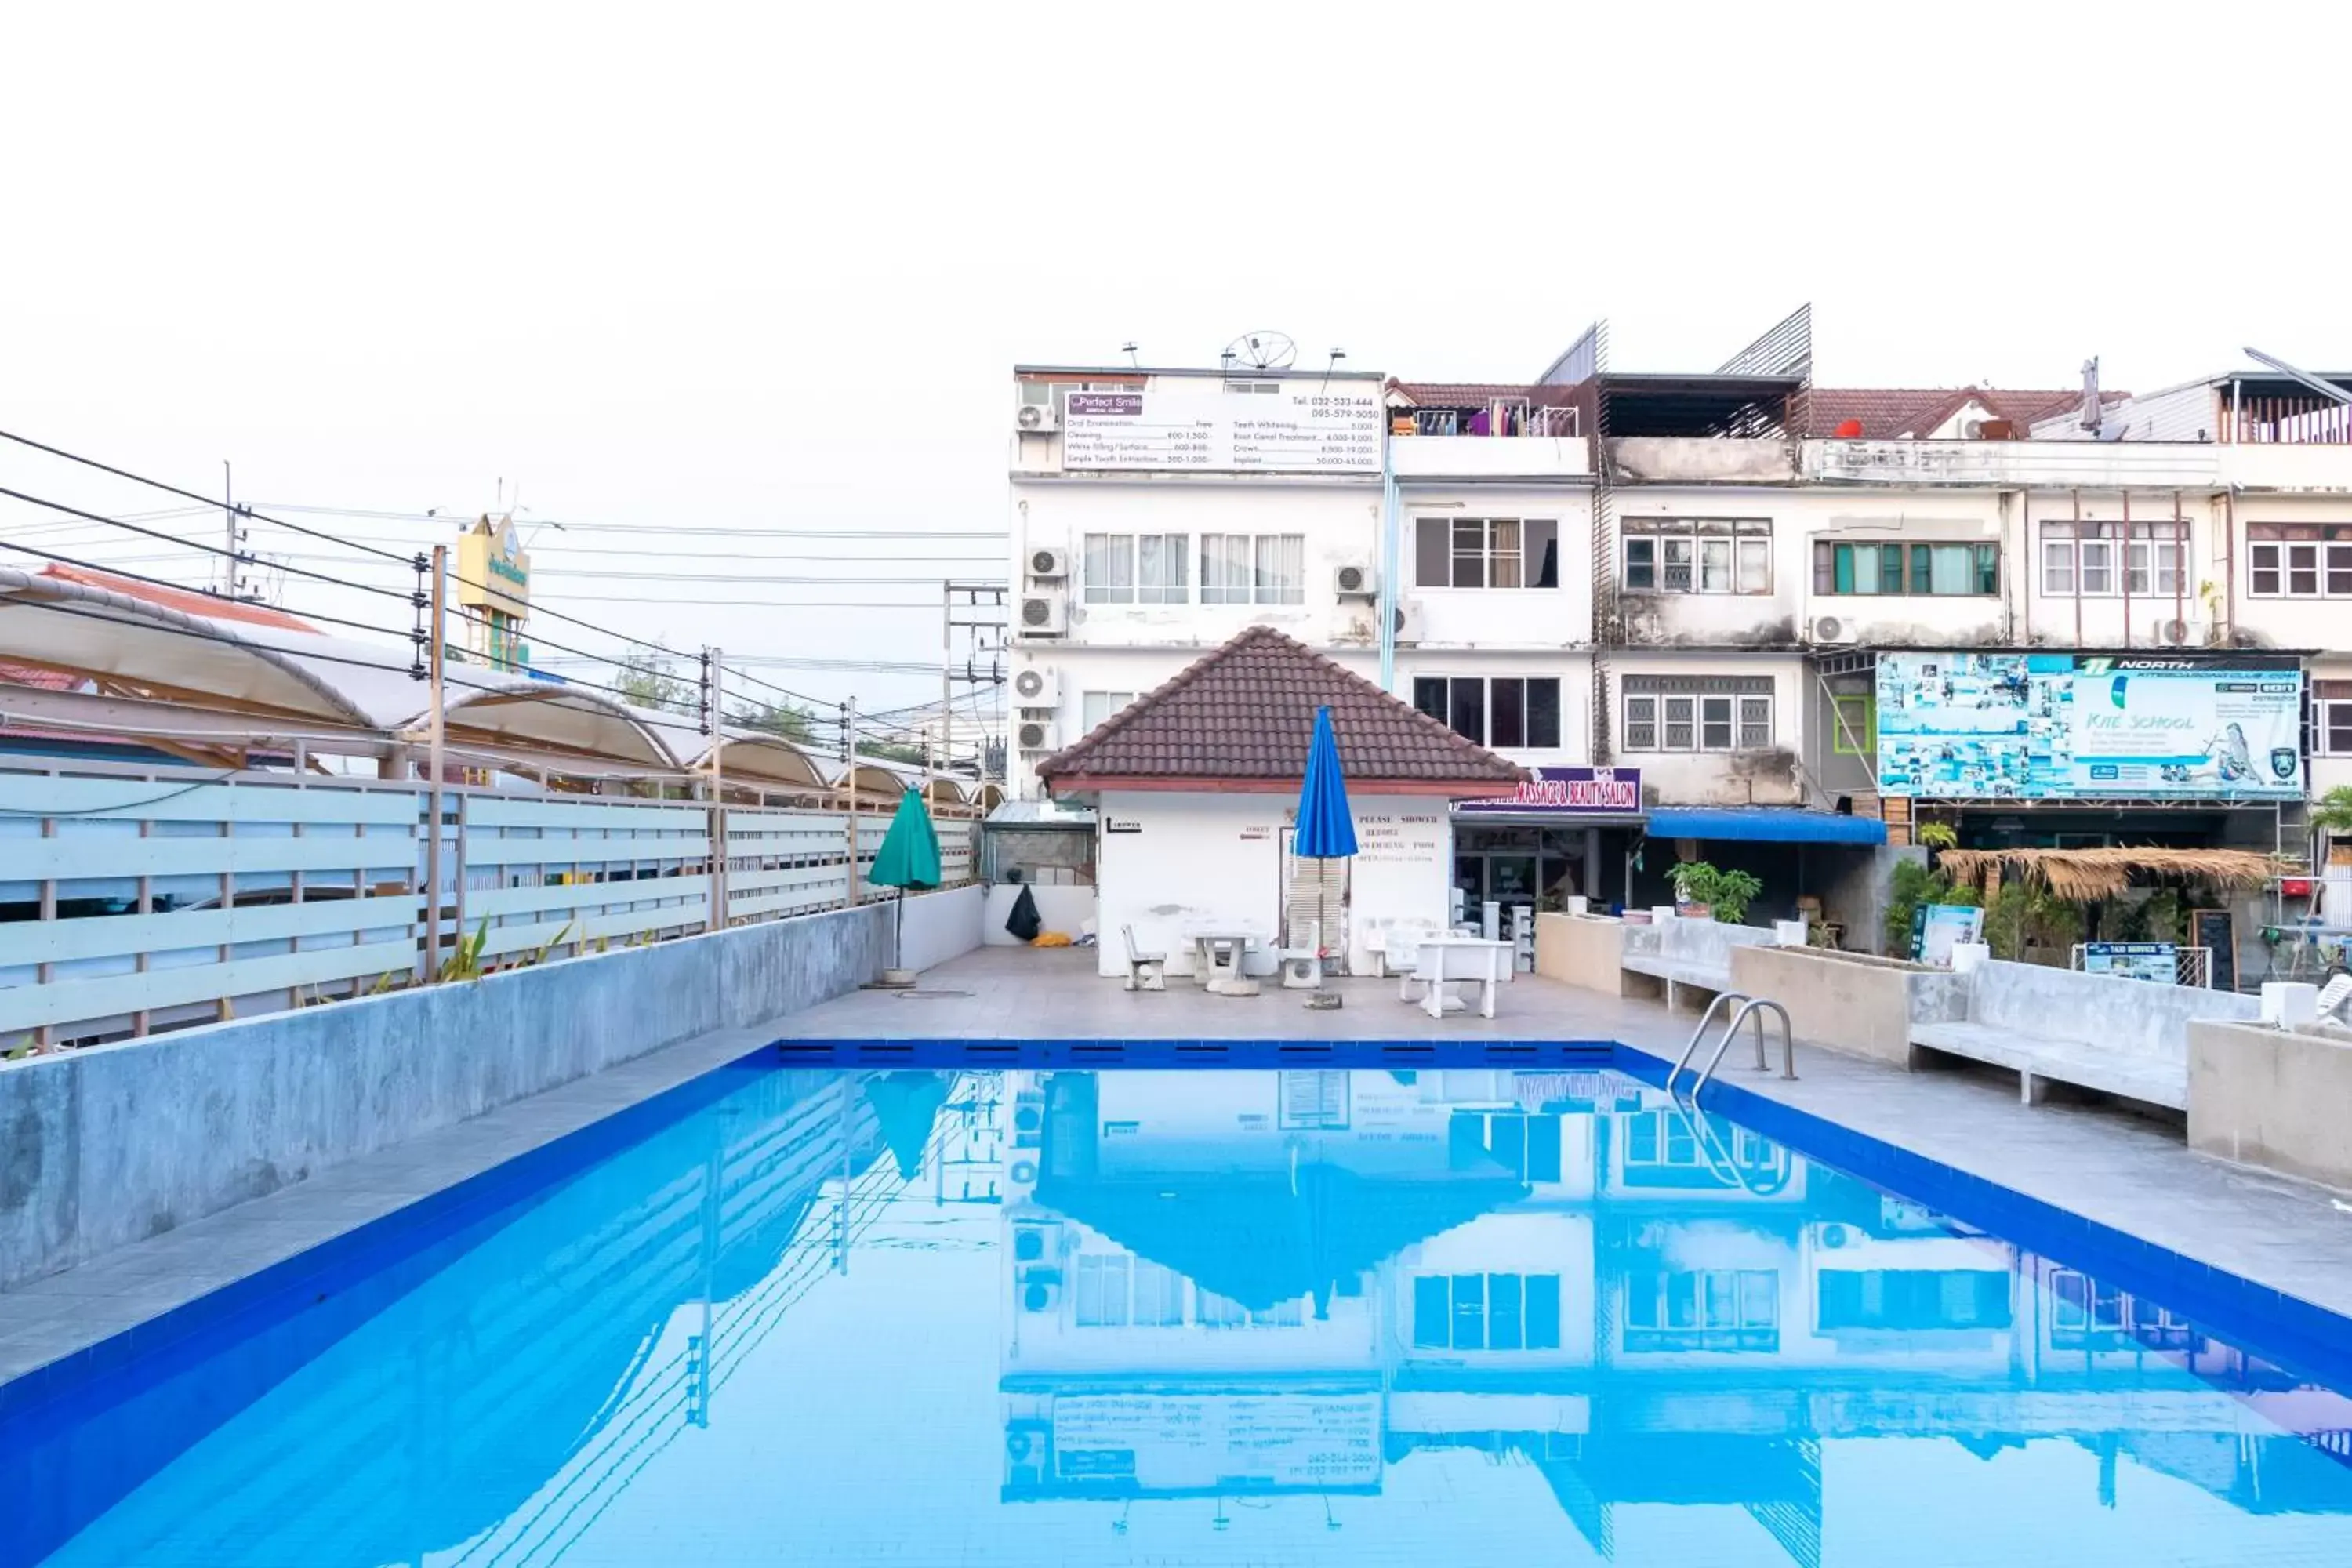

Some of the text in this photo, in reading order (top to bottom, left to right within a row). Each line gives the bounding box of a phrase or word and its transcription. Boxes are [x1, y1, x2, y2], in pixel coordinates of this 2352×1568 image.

[1080, 397, 1142, 407] Perfect Smile
[1067, 432, 1102, 441] Cleaning
[2119, 661, 2195, 670] NORTH
[1515, 781, 1559, 805] MASSAGE
[1569, 780, 1604, 807] BEAUTY
[1605, 781, 1636, 808] SALON
